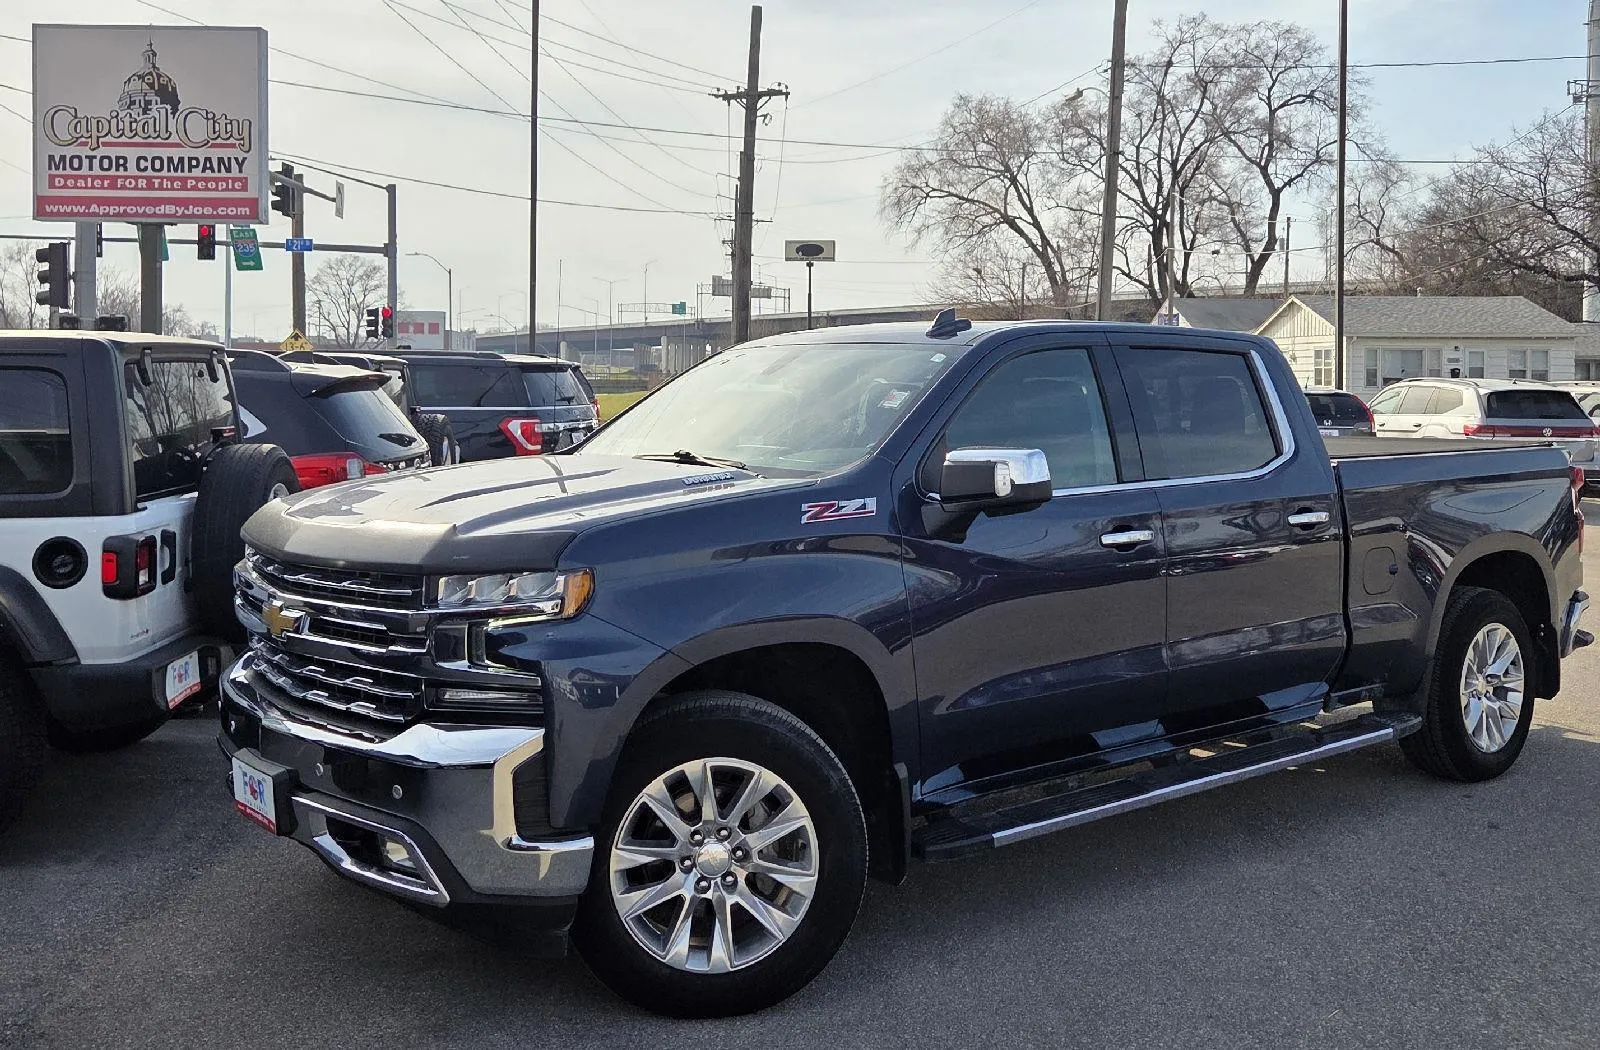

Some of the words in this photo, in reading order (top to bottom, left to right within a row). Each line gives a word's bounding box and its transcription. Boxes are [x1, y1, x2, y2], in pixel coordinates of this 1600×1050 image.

[43, 105, 172, 150] Capital
[176, 107, 252, 152] City
[48, 154, 128, 172] MOTOR
[135, 155, 248, 174] COMPANY
[54, 177, 110, 188] Dealer
[117, 178, 147, 189] FOR
[152, 178, 182, 189] The
[186, 179, 242, 191] People
[45, 202, 250, 216] www.ApprovedByJoe.com
[237, 243, 256, 253] 235
[801, 497, 877, 524] Z71
